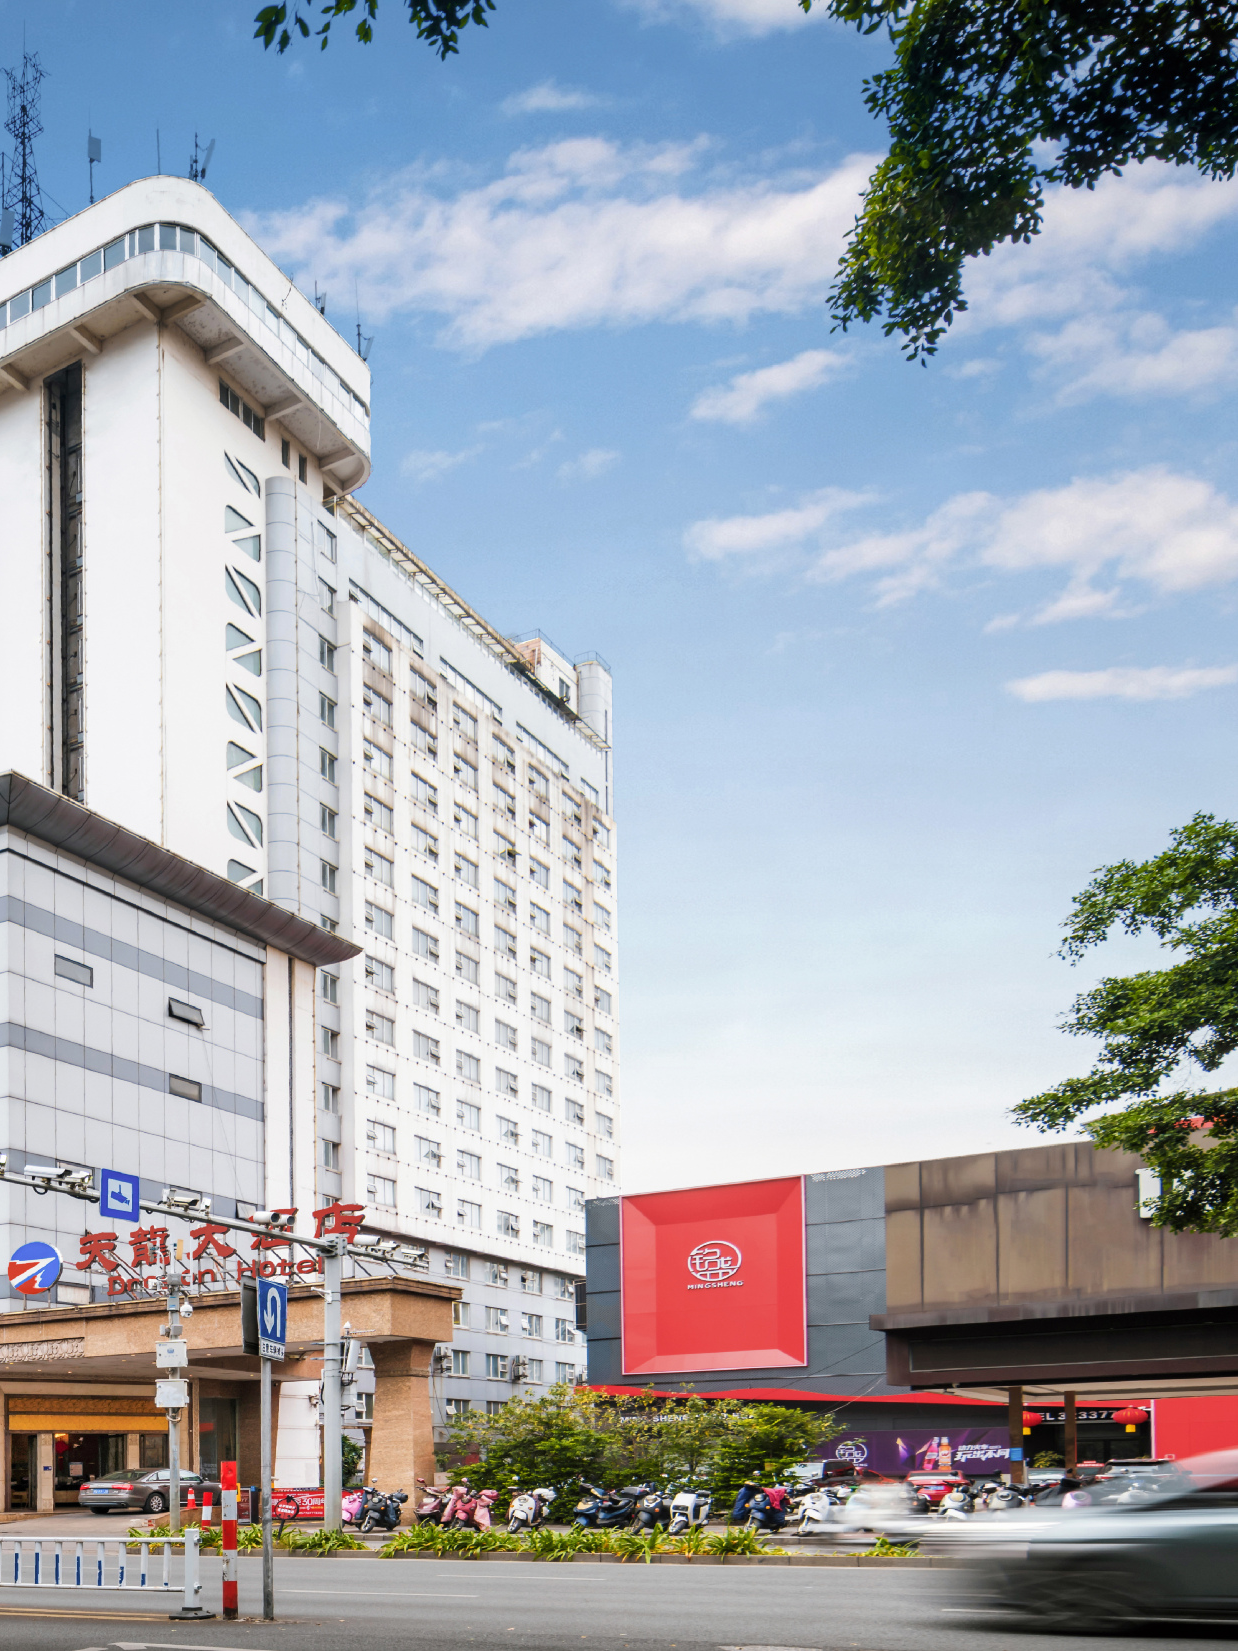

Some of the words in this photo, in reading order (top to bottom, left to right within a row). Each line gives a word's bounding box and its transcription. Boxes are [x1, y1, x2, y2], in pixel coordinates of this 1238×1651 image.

[107, 1268, 215, 1296] Dron
[237, 1256, 322, 1281] Hotel
[687, 1280, 744, 1290] MINGSHENG
